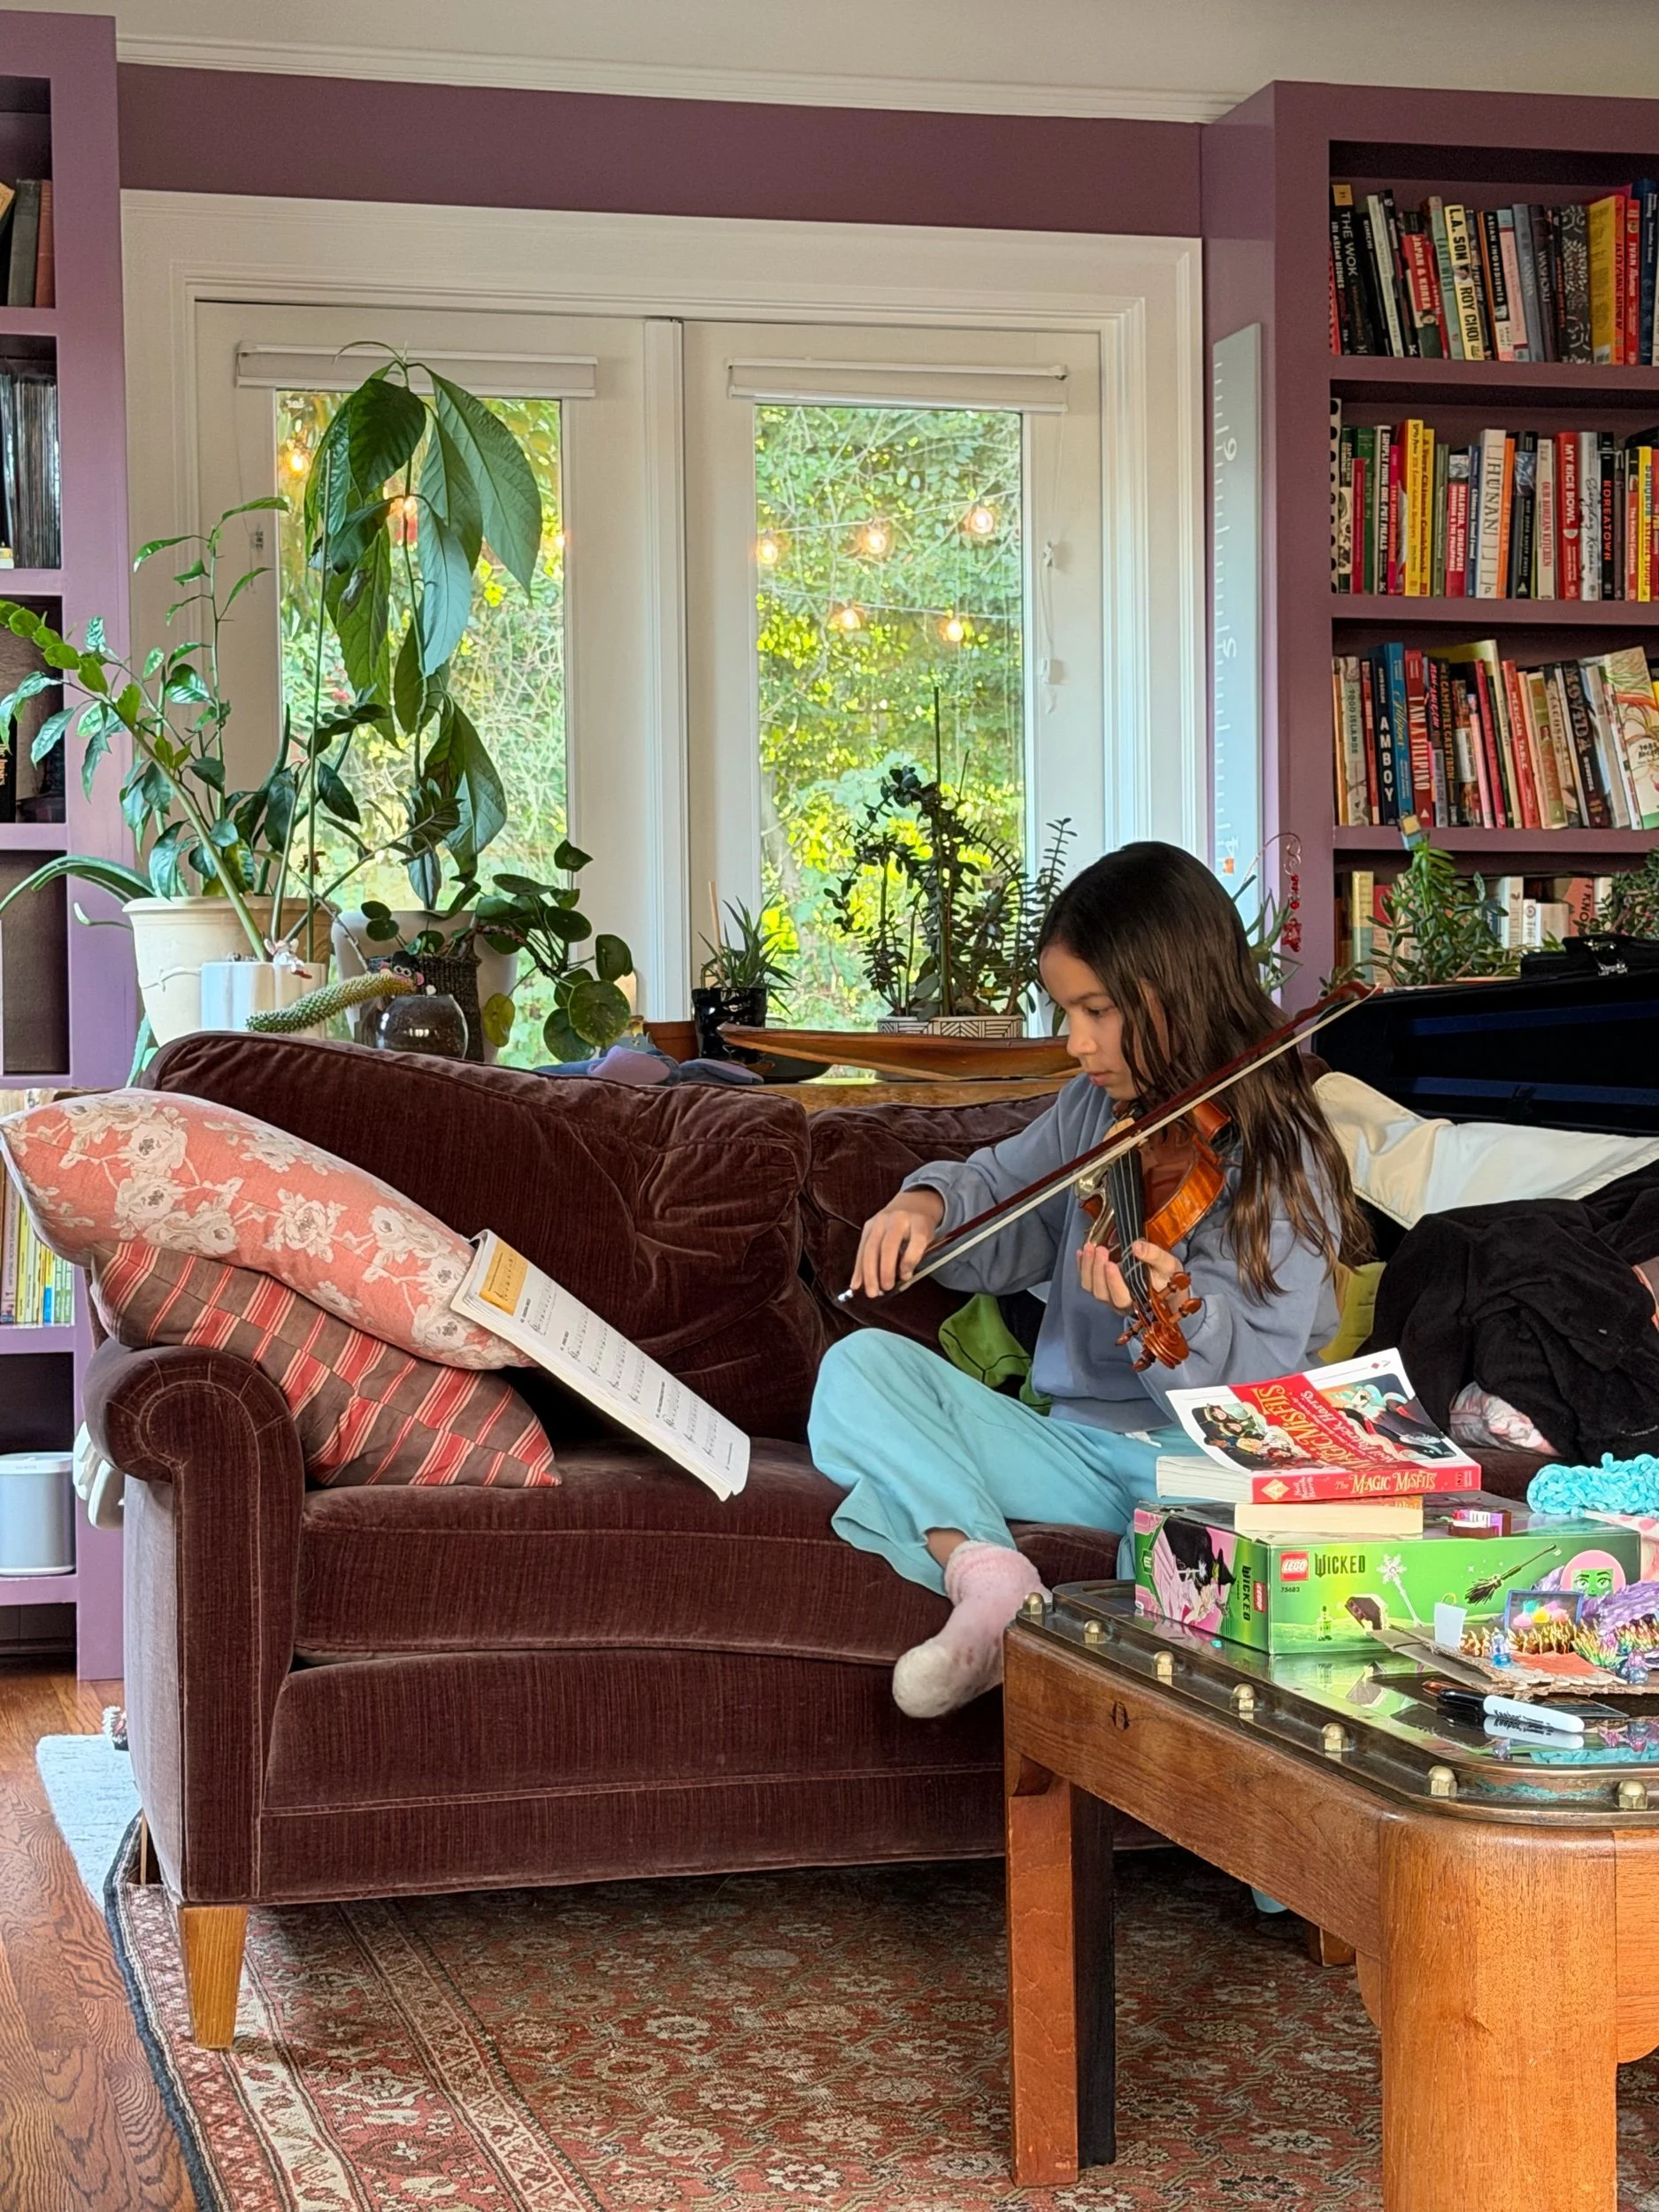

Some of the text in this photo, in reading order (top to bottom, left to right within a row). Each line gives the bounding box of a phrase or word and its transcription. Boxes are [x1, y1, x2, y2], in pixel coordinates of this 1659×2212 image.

[1340, 211, 1354, 240] THE
[1449, 208, 1468, 261] L.A. SON
[1343, 242, 1358, 277] WOK
[1412, 235, 1425, 267] JAPAN
[1487, 214, 1504, 303] ASIAN INGREDIENTS
[1628, 242, 1638, 266] IVAN
[1417, 278, 1432, 311] KOREA
[1460, 287, 1475, 311] ROY
[1463, 313, 1480, 343] CHOI
[1483, 462, 1501, 533] HUNAN
[1564, 443, 1576, 526] MY RICE BOWL
[1379, 522, 1388, 550] MEALS
[1602, 480, 1612, 562] KOREATOWN
[1455, 528, 1464, 572] SINGAPORE
[1409, 705, 1426, 723] AM
[1440, 680, 1451, 730] CAMPFIRE
[1349, 714, 1359, 755] ISLANDS
[1411, 725, 1427, 734] A
[1444, 730, 1454, 754] CAST
[1510, 691, 1524, 737] MEXICAN
[1517, 739, 1528, 771] TABLE
[1380, 716, 1394, 802] AMBOY
[1411, 738, 1431, 791] FILIPINO
[1446, 757, 1455, 780] IRON
[1281, 1553, 1366, 1578] LEGO WICKED
[1241, 1564, 1252, 1622] WICKED
